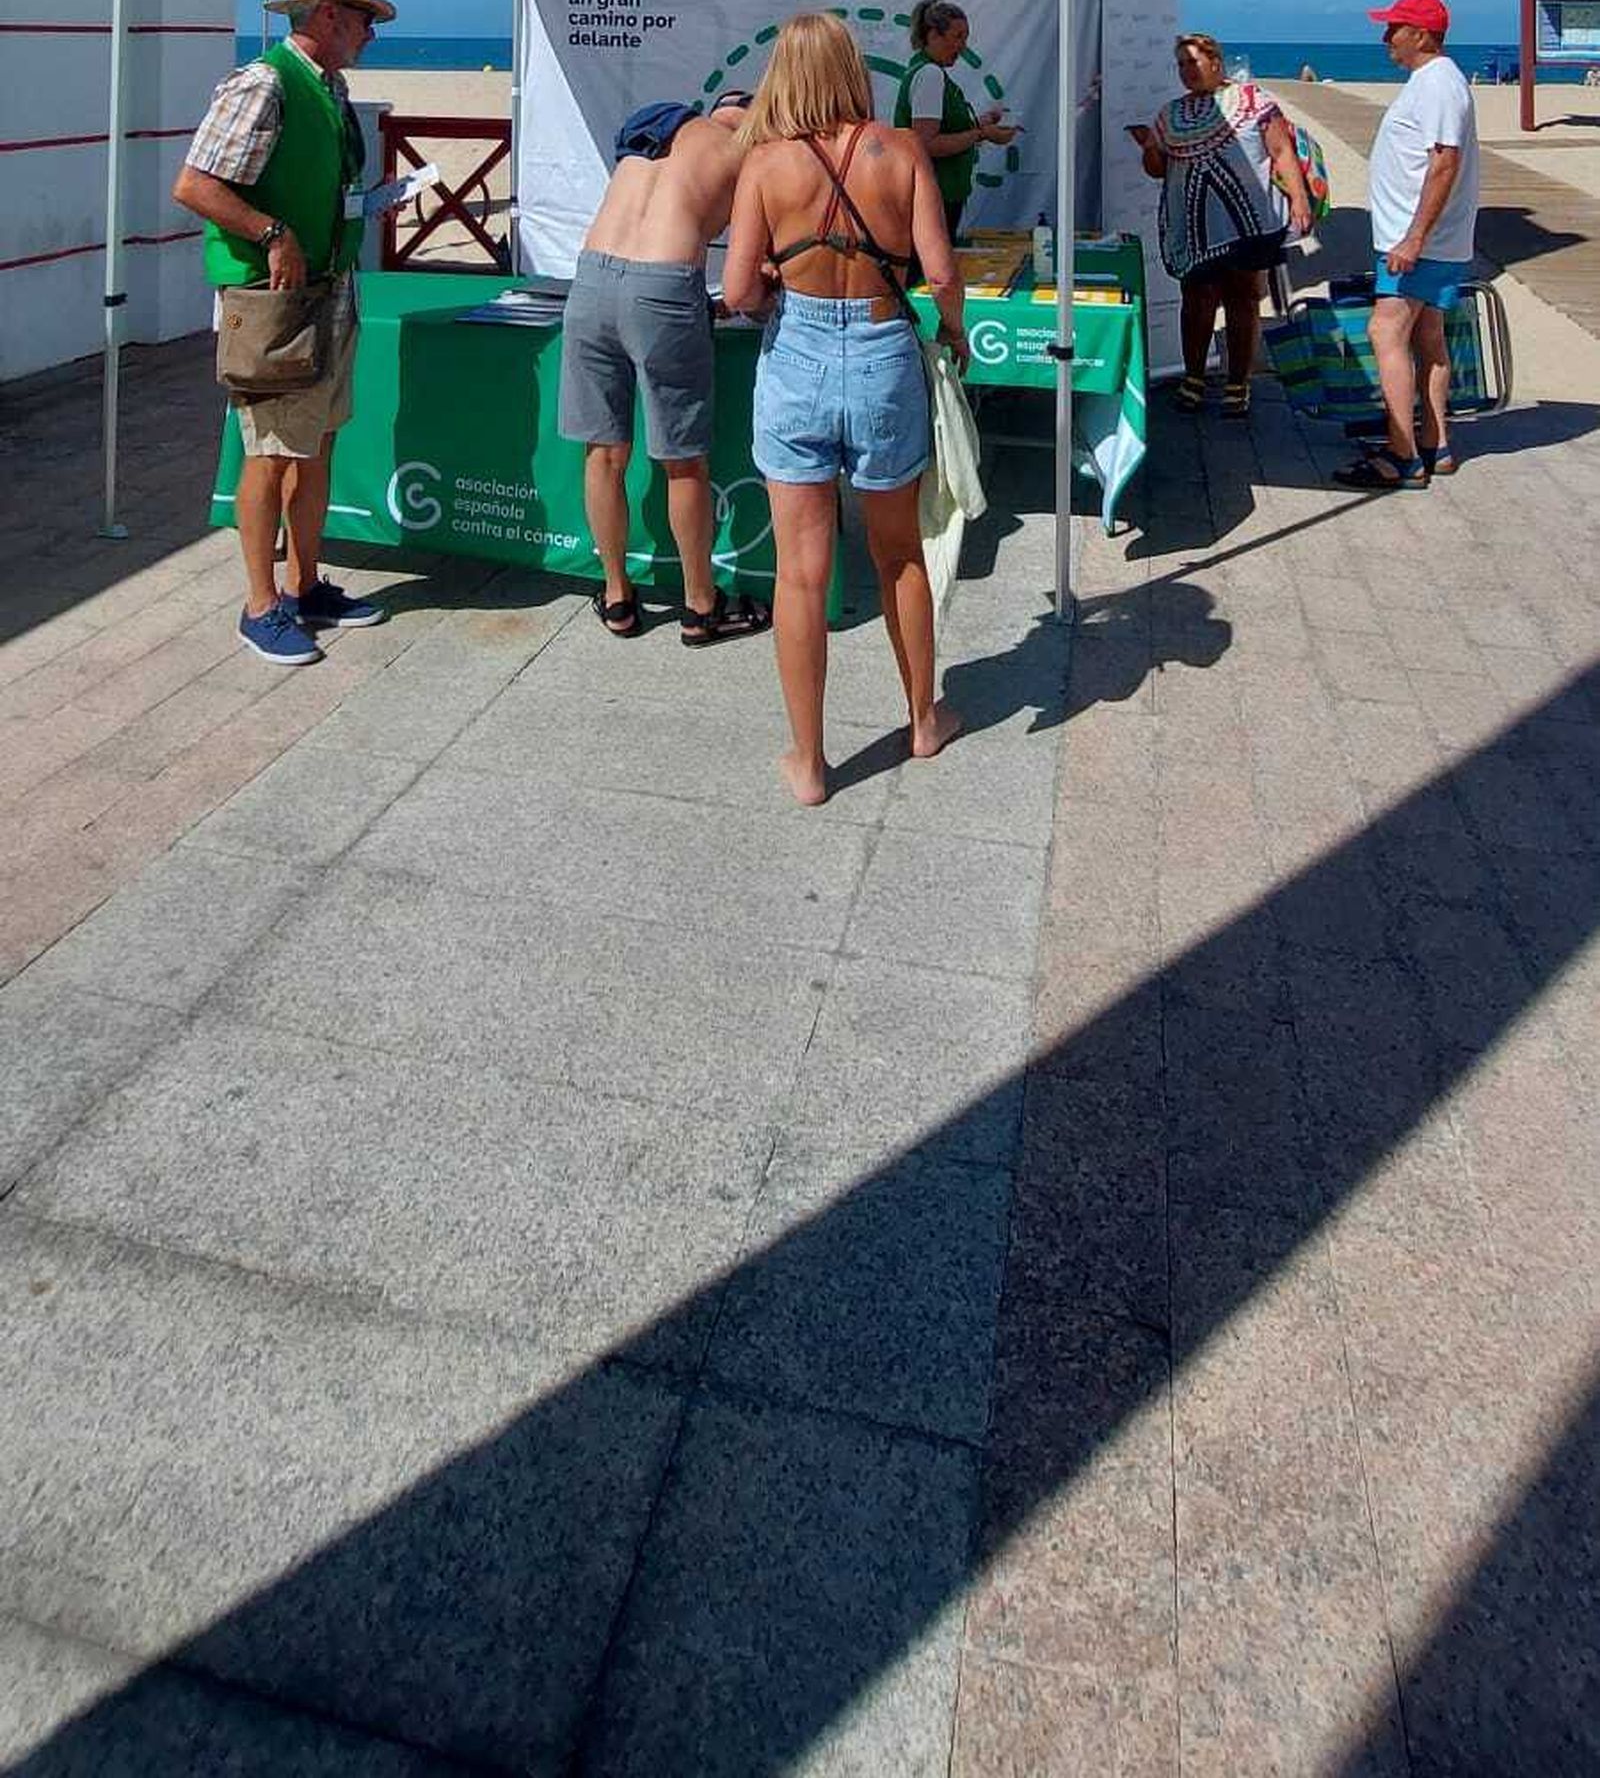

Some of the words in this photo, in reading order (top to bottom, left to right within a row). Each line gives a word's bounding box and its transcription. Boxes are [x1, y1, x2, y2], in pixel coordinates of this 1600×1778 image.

[568, 10, 638, 27] camino
[643, 16, 676, 32] por
[568, 30, 642, 48] delante
[455, 477, 539, 500] asociación
[454, 498, 526, 520] española
[452, 518, 502, 538] contra
[506, 525, 520, 540] el
[524, 526, 580, 550] cáncer
